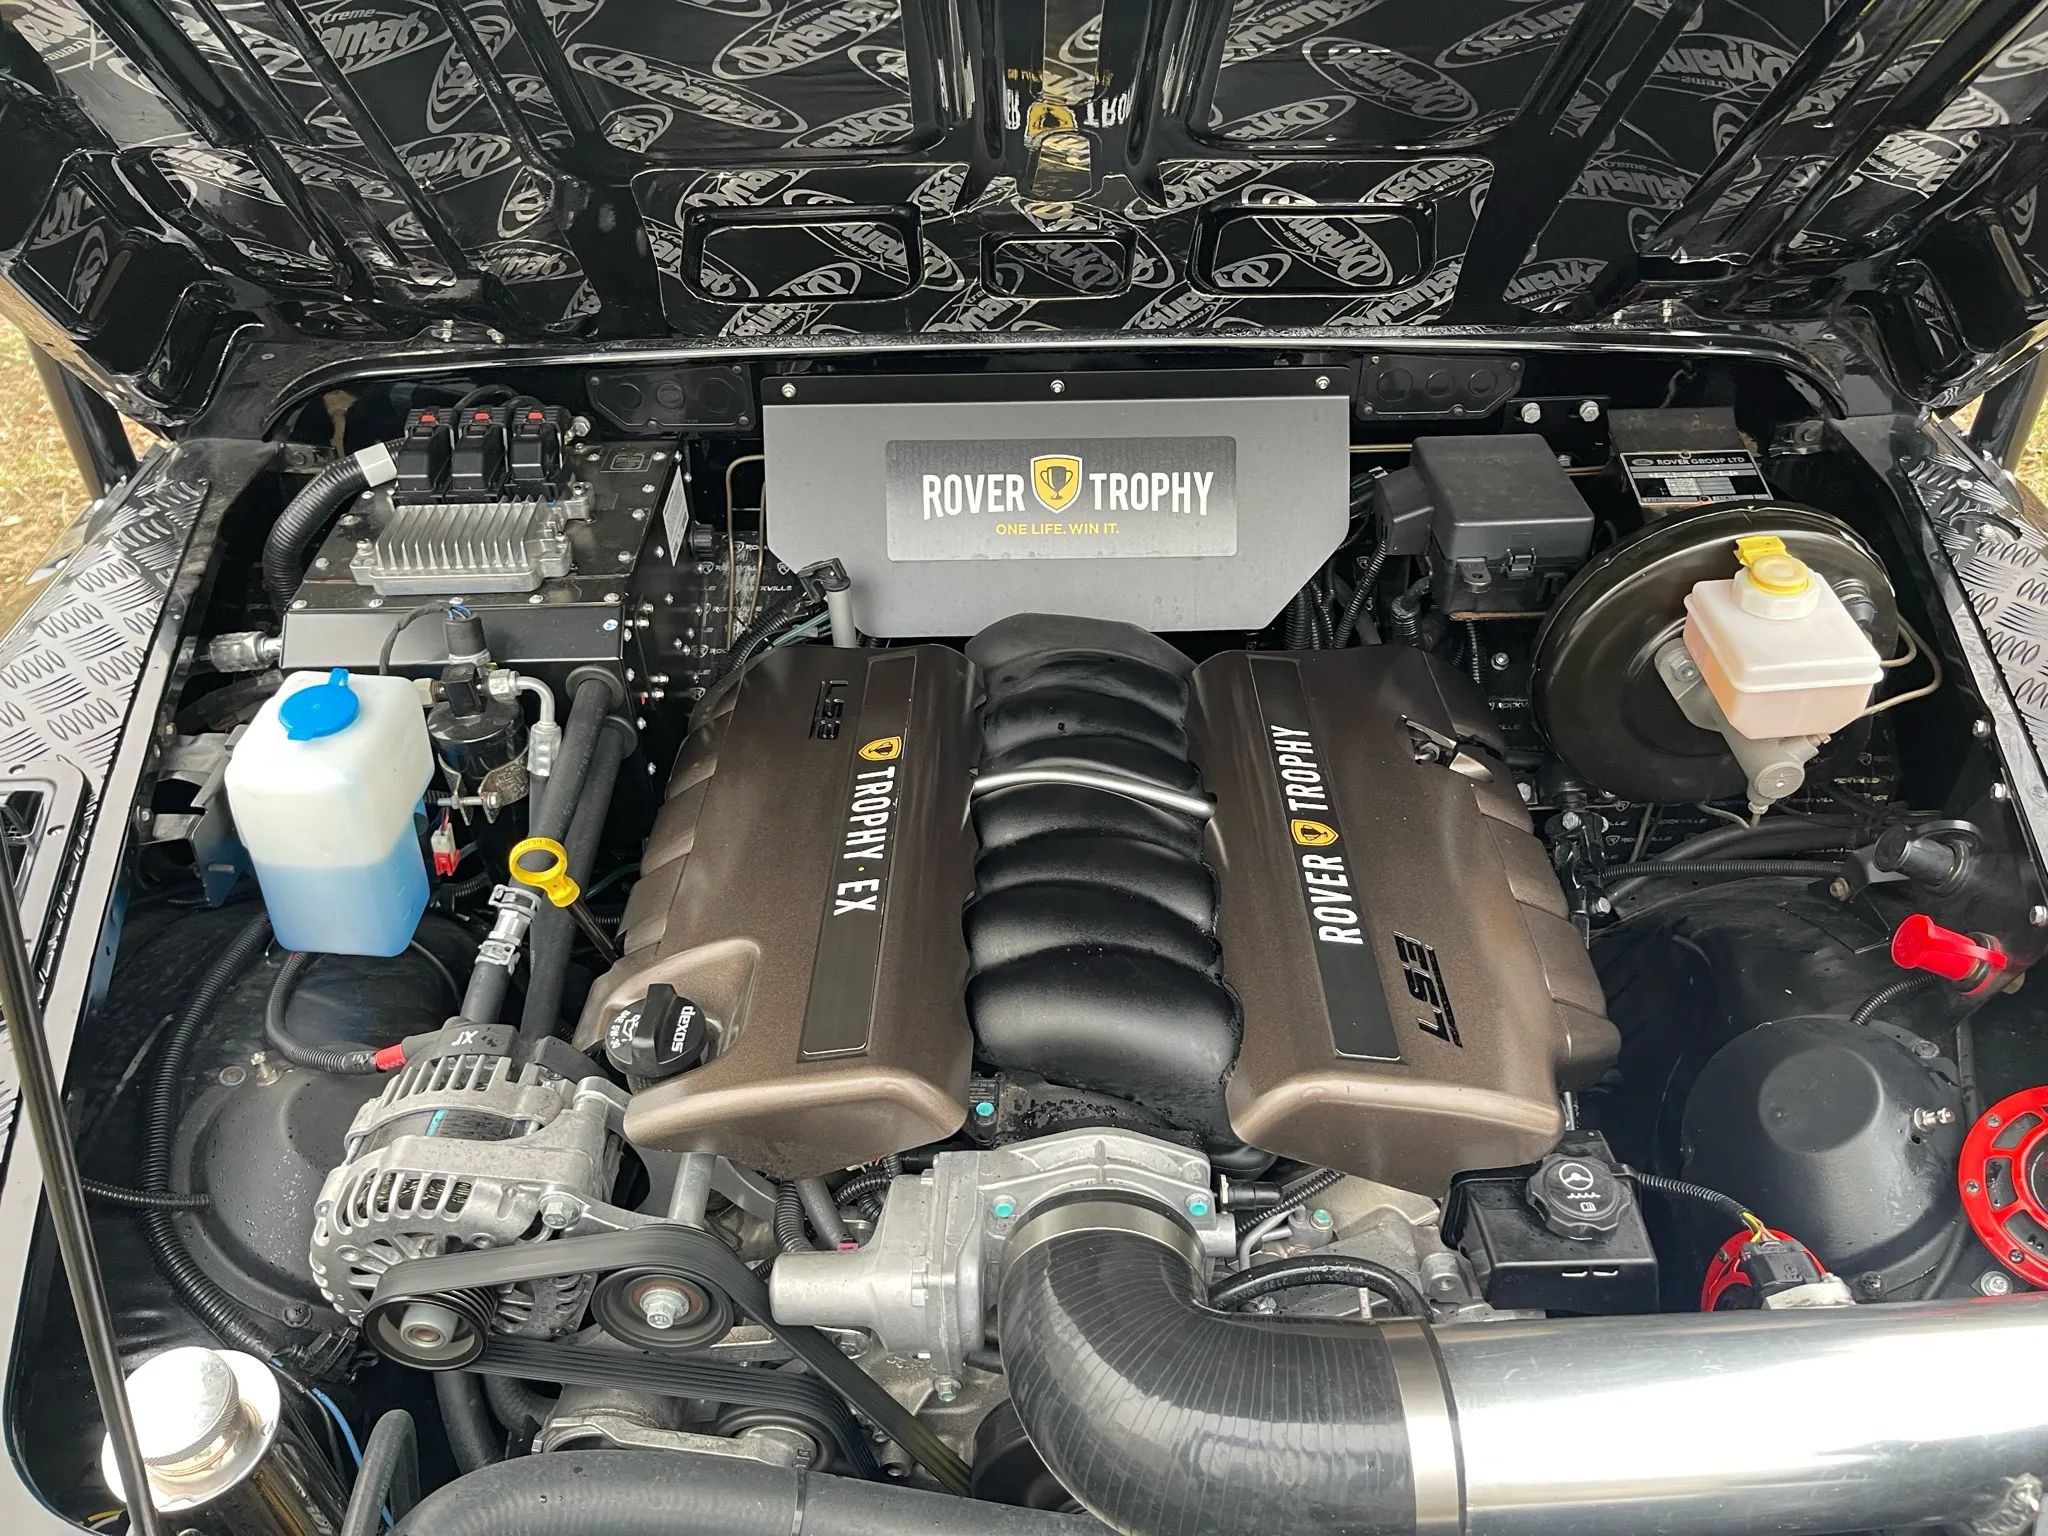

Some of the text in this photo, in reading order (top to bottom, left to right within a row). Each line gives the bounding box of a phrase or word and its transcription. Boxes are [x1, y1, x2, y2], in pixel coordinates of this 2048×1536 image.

[592, 53, 783, 129] Dynamat
[1656, 458, 1690, 466] ROVER
[1691, 457, 1726, 465] GROUP
[1727, 456, 1746, 464] LTD
[922, 471, 1214, 520] ROVER TROPHY
[996, 522, 1120, 535] ONE LIFE. WIN IT.
[811, 679, 849, 740] LS3
[833, 765, 896, 916] TROPHY EX
[1271, 725, 1364, 945] ROVER TROPHY
[1393, 929, 1456, 1046] LS3
[671, 1005, 697, 1054] dexos
